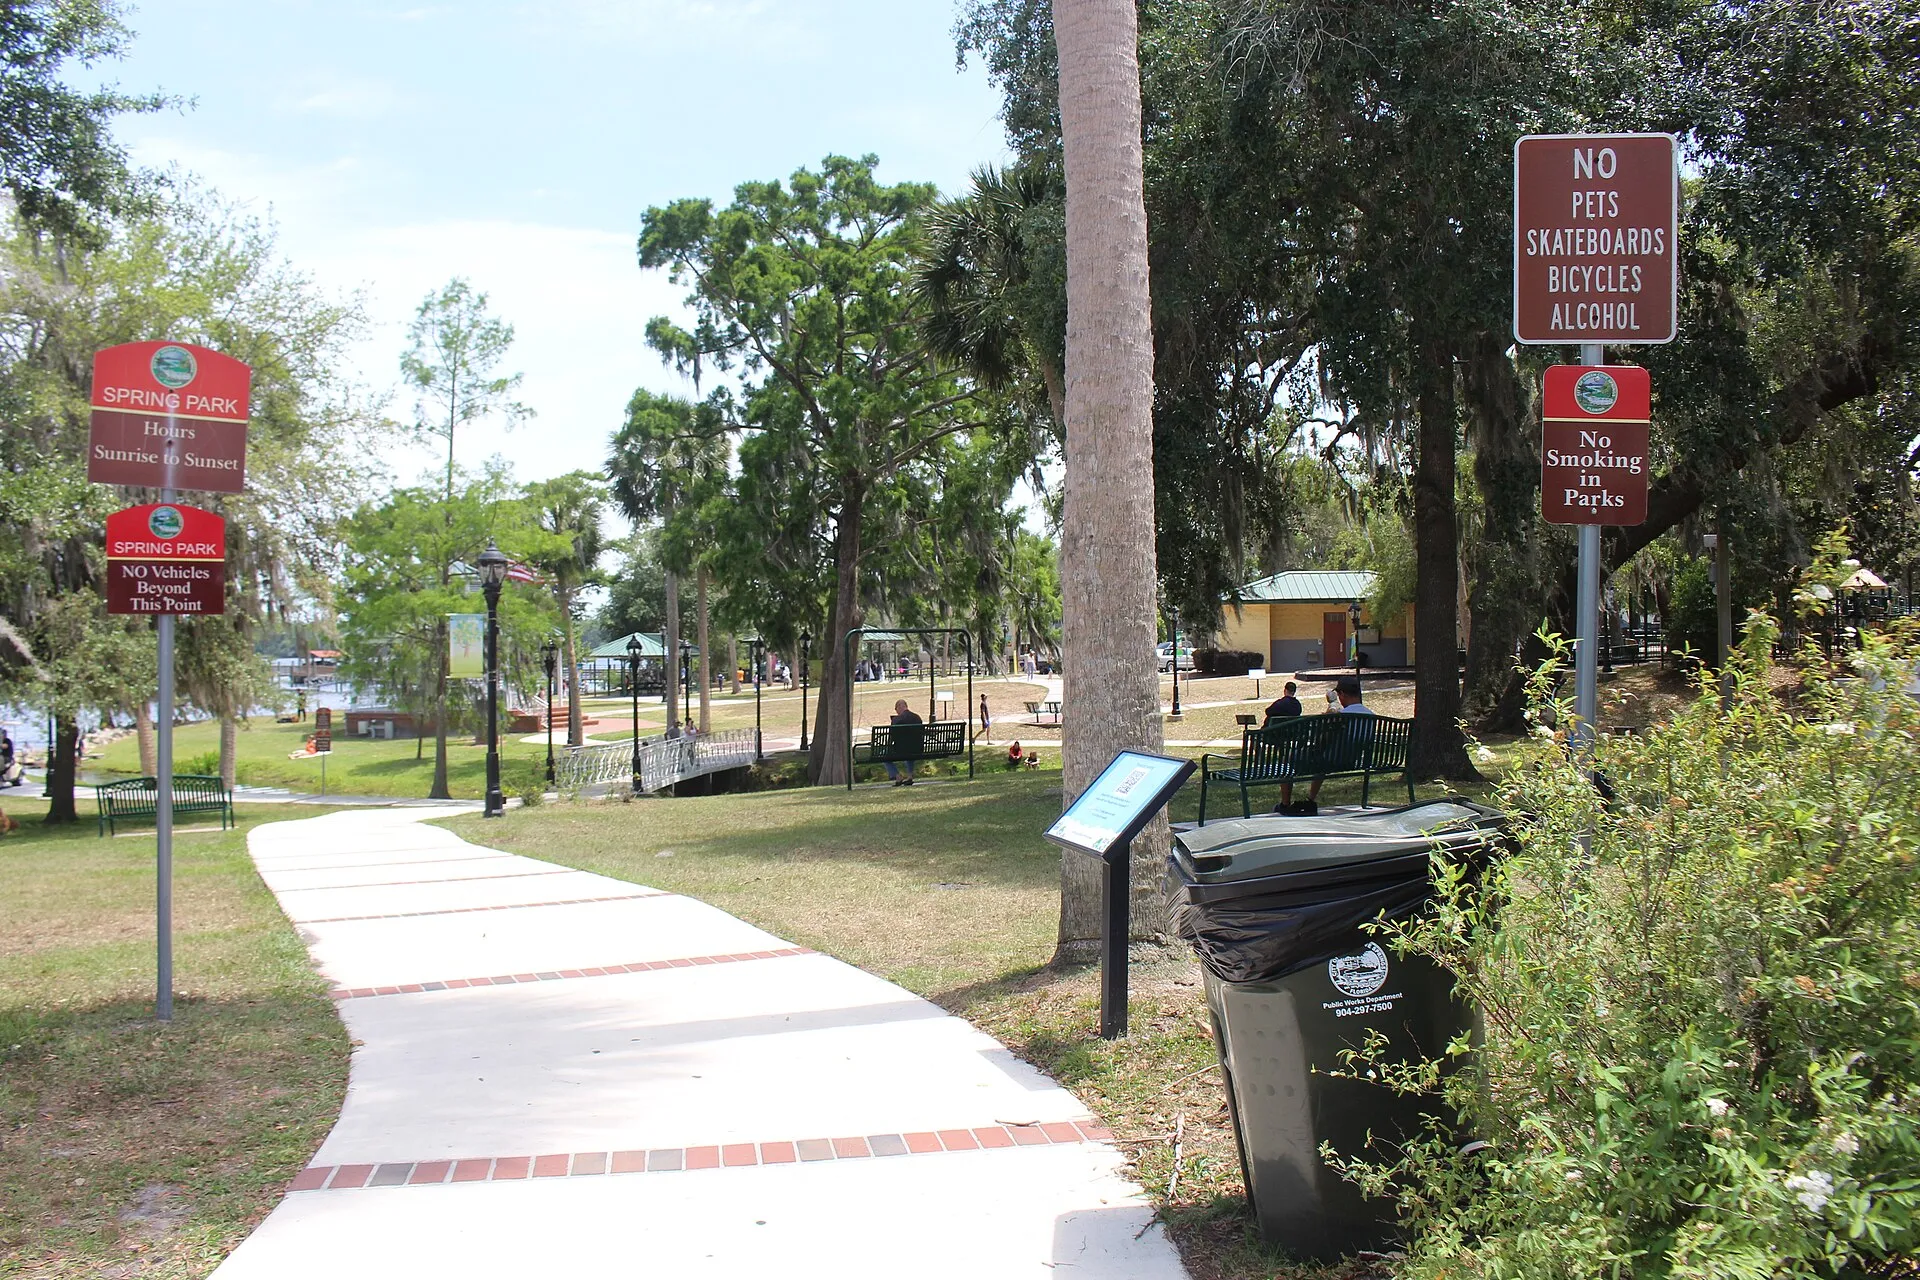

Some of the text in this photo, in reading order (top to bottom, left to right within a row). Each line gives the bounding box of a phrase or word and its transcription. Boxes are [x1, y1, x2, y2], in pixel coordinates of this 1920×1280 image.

[1574, 148, 1617, 180] NO
[1572, 191, 1619, 218] PETS
[1526, 228, 1665, 256] SKATEBOARDS
[1549, 265, 1642, 293] BICYCLES
[1550, 303, 1640, 330] ALCOHOL
[103, 387, 238, 414] SPRING PARK
[144, 421, 196, 439] Hours
[1579, 430, 1611, 448] No
[94, 445, 238, 471] Sunrise to Sunset
[1546, 449, 1643, 474] Smoking
[1579, 469, 1601, 487] in
[1563, 489, 1624, 507] Parks
[114, 541, 216, 555] SPRING PARK
[122, 565, 210, 579] NO Vehicles
[137, 581, 191, 597] Beyond
[130, 598, 202, 611] This Point
[1322, 992, 1403, 1010] Public Works Department
[1335, 1001, 1393, 1017] 904-297-7500
